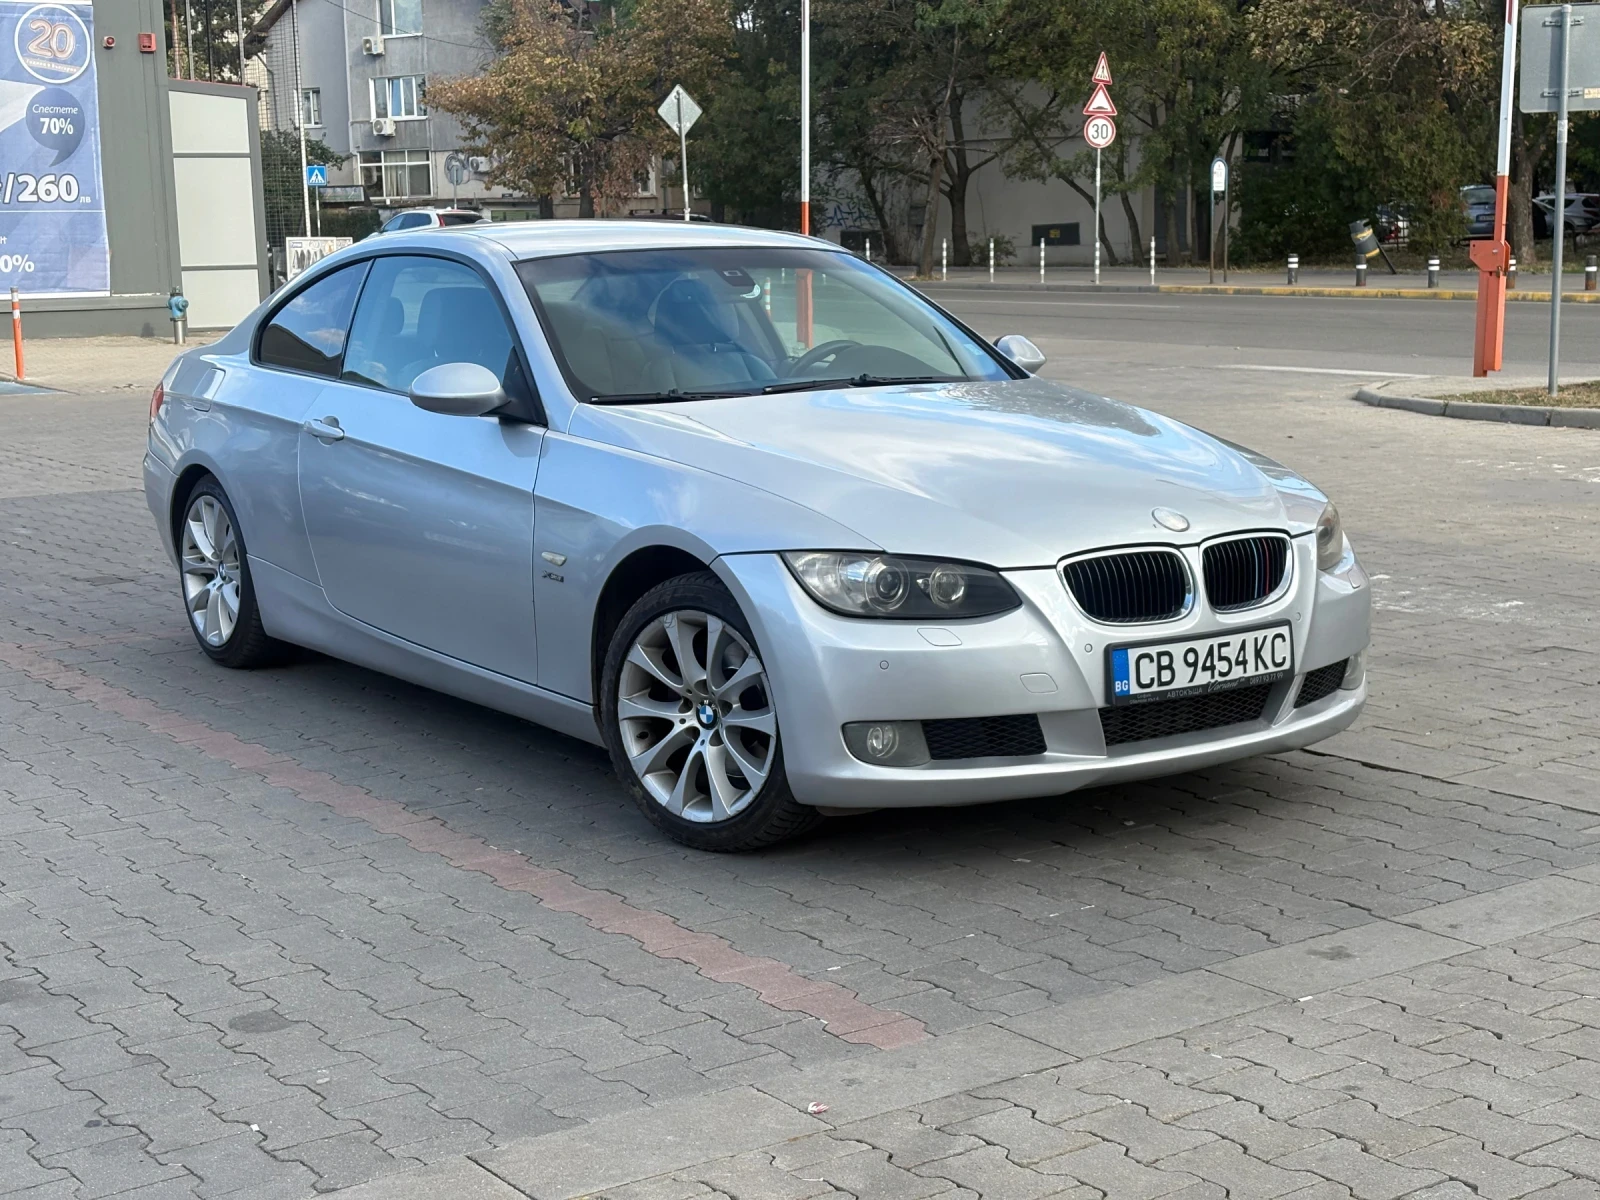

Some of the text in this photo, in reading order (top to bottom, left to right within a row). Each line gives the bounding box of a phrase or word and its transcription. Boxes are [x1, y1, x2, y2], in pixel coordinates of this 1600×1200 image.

[28, 18, 75, 59] 20
[32, 104, 78, 115] Спестете
[40, 117, 74, 135] 70%
[1091, 124, 1109, 139] 30
[1135, 632, 1287, 690] CB 9454 KC
[1115, 680, 1129, 692] BG
[1167, 688, 1203, 698] АВТОКЪЩА
